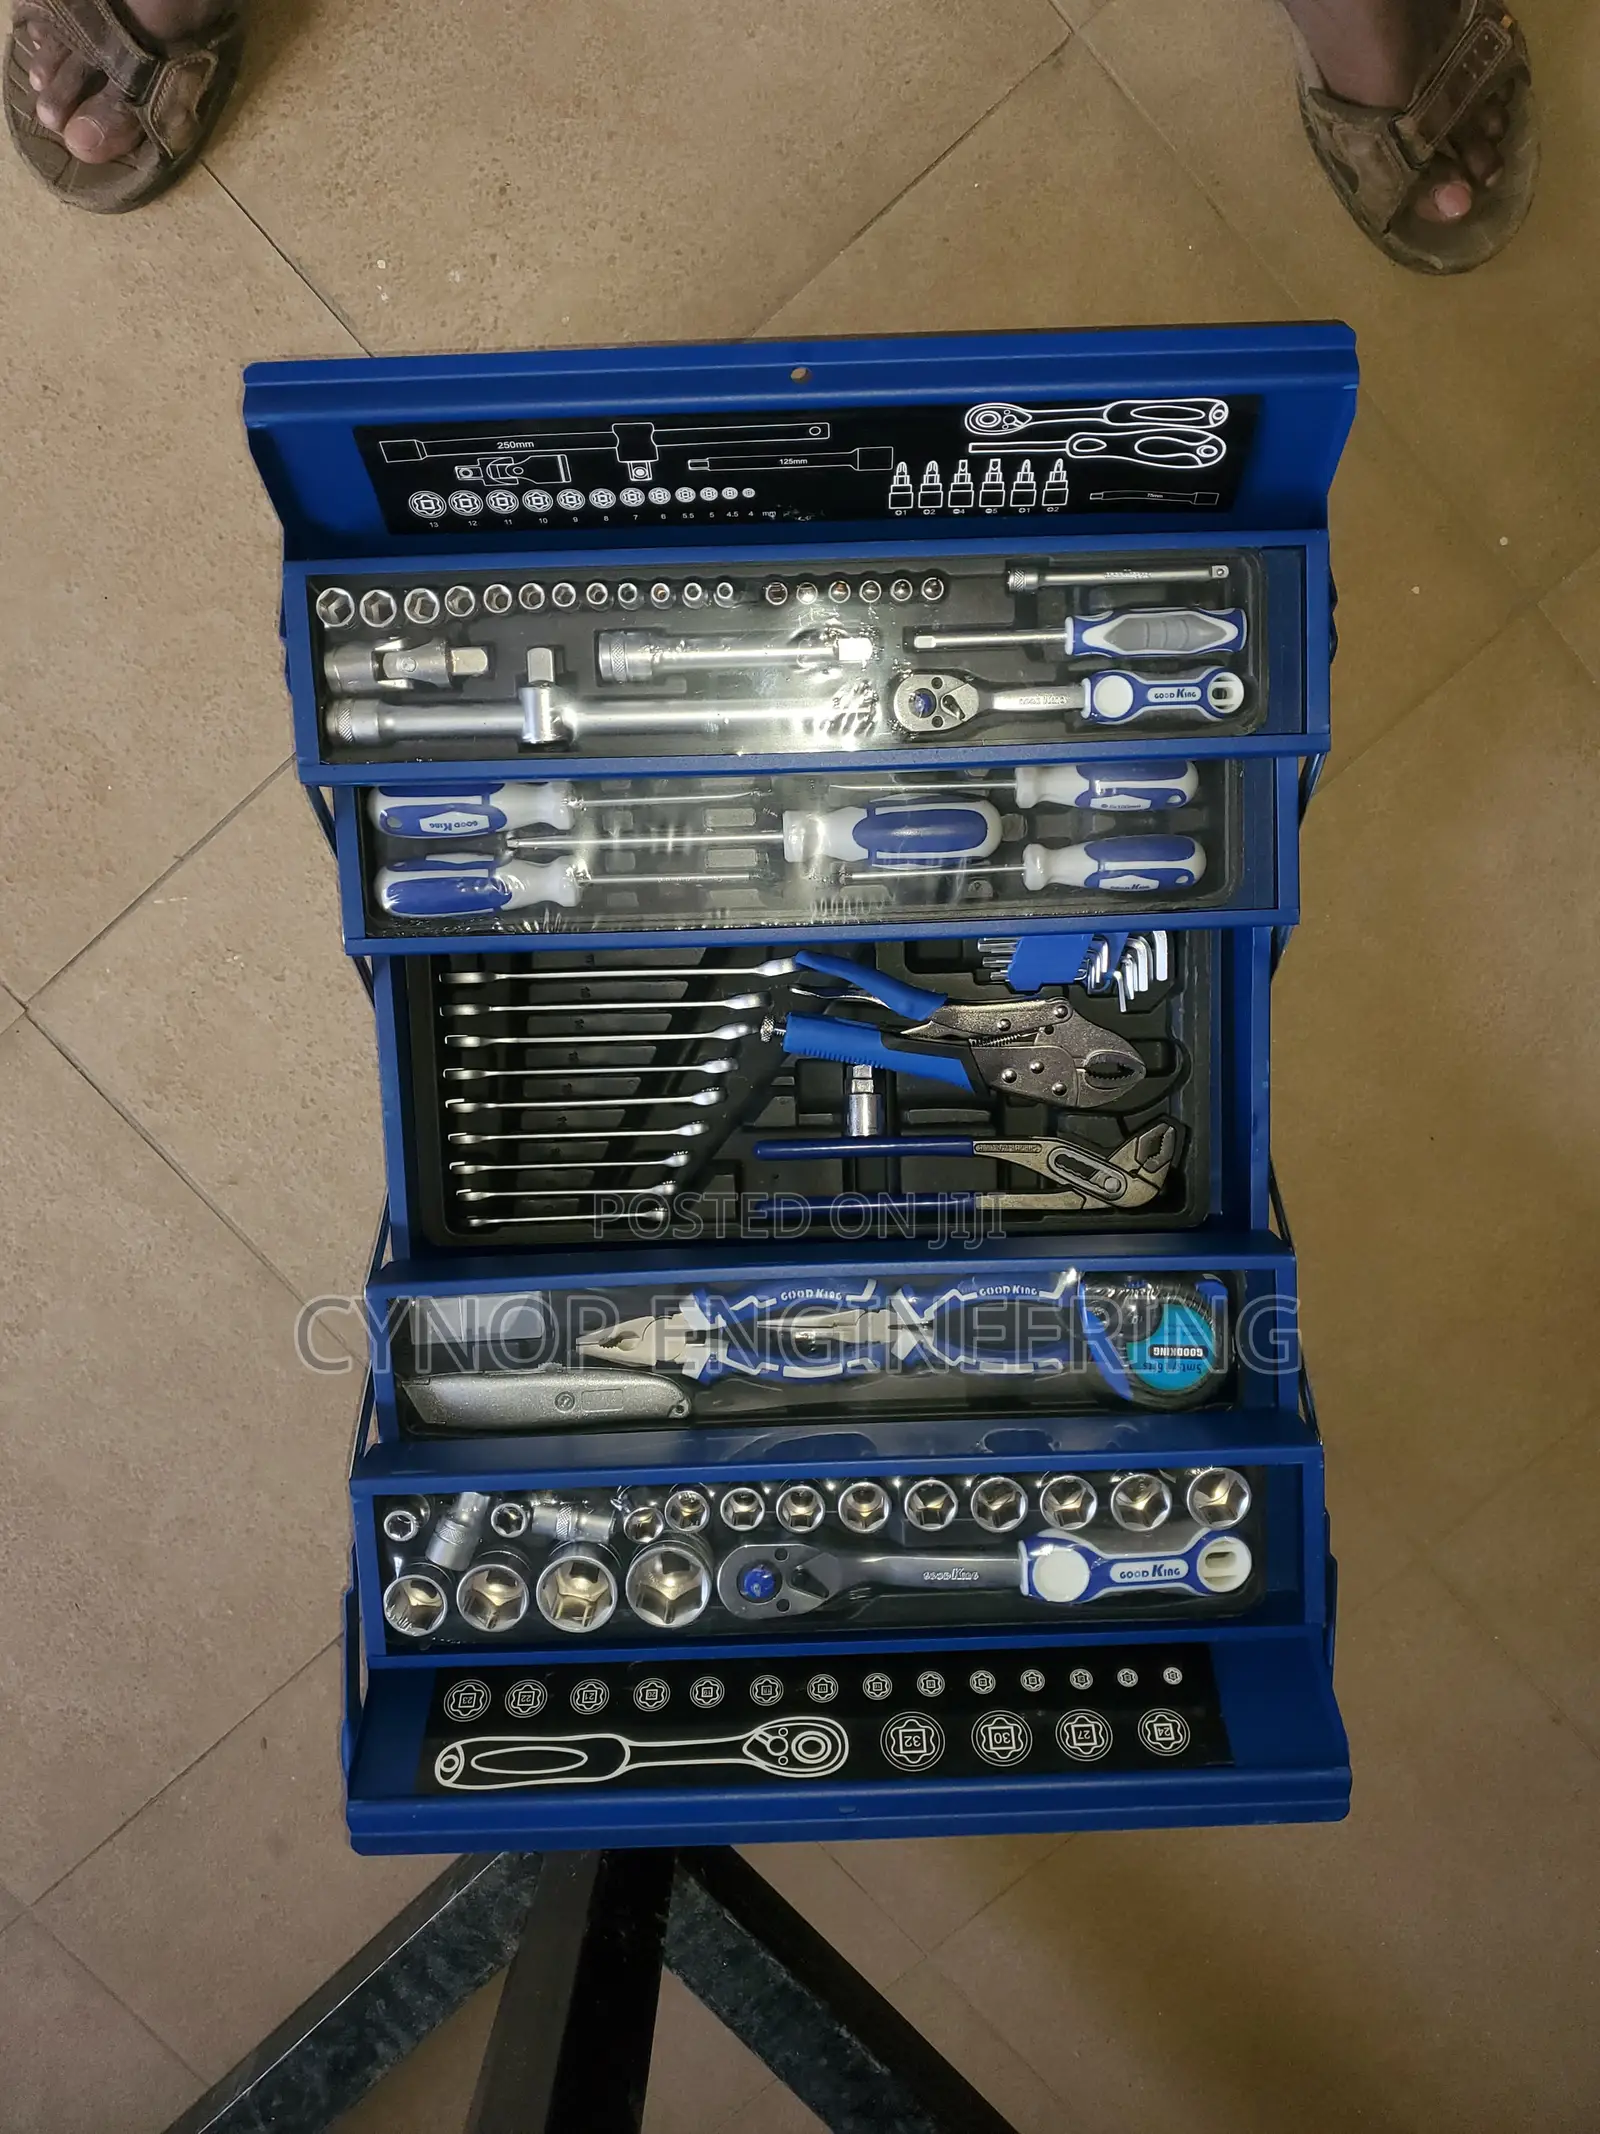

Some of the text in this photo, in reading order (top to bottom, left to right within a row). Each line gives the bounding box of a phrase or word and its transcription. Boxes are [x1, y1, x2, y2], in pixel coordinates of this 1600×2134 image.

[496, 440, 535, 450] 250mm
[453, 820, 479, 828] GOOD
[781, 1288, 814, 1300] GOOD
[979, 1285, 1011, 1296] GOOD
[1153, 1346, 1204, 1357] GOODKING
[1119, 1570, 1150, 1579] GOOD
[462, 1696, 474, 1704] 23
[520, 1694, 532, 1703] 22
[584, 1692, 595, 1700] 21
[903, 1727, 1171, 1748] 32 30 27 24
